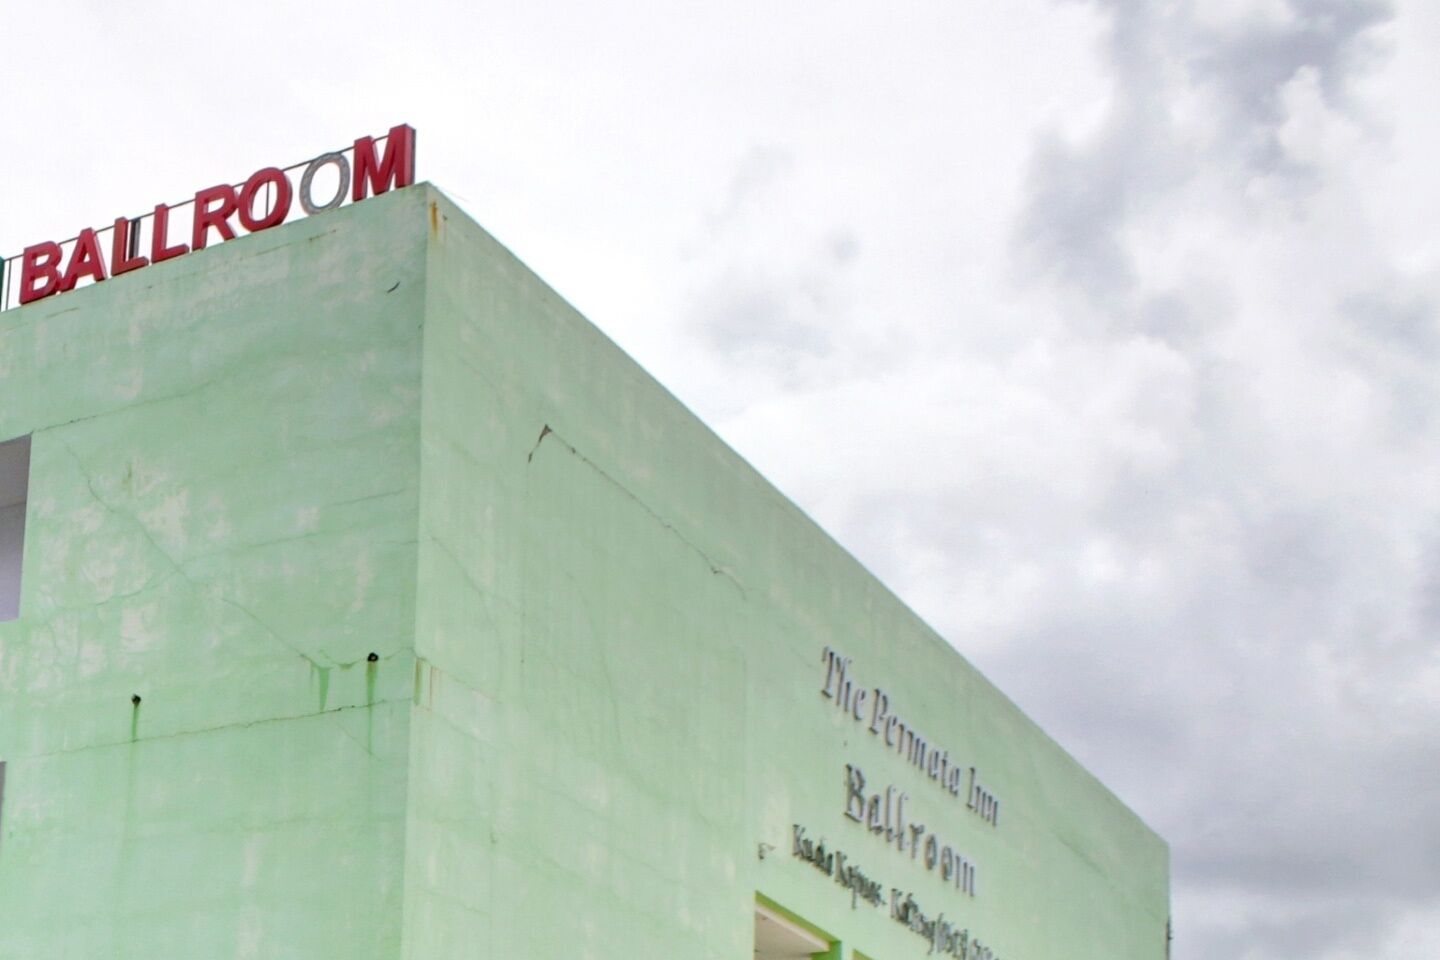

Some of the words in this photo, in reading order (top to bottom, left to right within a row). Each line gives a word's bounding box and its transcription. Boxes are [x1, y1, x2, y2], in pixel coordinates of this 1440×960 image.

[19, 123, 416, 306] BALLROOM
[821, 646, 866, 721] The
[868, 688, 961, 798] Permata
[966, 766, 999, 828] Inn
[843, 763, 975, 898] Ballroom
